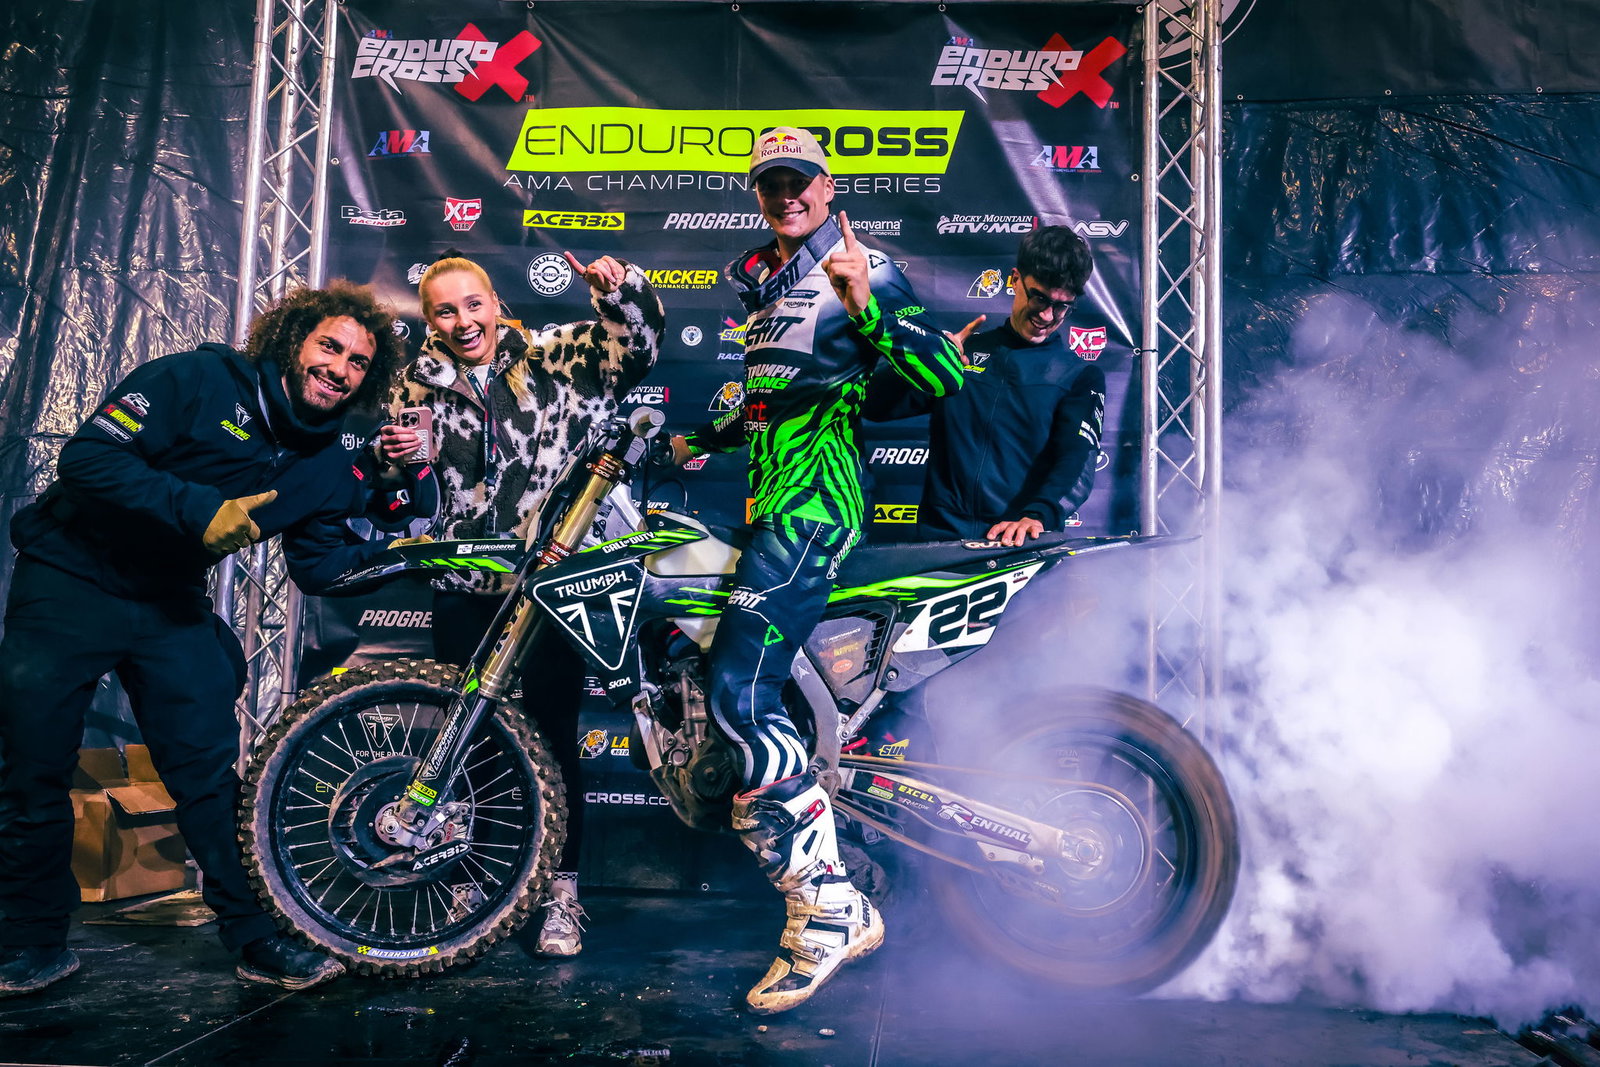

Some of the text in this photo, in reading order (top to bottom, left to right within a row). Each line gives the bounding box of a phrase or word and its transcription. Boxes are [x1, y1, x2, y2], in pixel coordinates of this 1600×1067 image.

[947, 36, 974, 46] AMA
[351, 57, 466, 95] CROSS
[931, 65, 1052, 104] CROSS
[367, 130, 431, 156] AMA
[525, 123, 948, 157] ENDUROROSS
[761, 145, 802, 157] Red Bull
[1030, 145, 1101, 169] AMA
[503, 174, 941, 193] AMA CHAMPION SERIES
[341, 205, 405, 219] Beta
[443, 201, 482, 222] XC
[662, 212, 774, 230] PROGRESSIV
[951, 214, 1033, 222] ROCKY MOUNTAIN
[848, 219, 902, 232] usqvarna
[1074, 219, 1129, 238] ASV
[532, 256, 570, 272] BULLET
[532, 278, 567, 293] PROOF
[651, 269, 719, 285] KICKER
[1069, 331, 1107, 351] XC
[1081, 352, 1096, 360] GEAR
[632, 386, 664, 394] UNTAIN
[473, 543, 517, 552] Silkolene
[602, 539, 625, 554] CALL
[629, 531, 656, 544] DUTY
[554, 570, 633, 599] TRIUMPH
[358, 609, 432, 628] PROGRE
[928, 581, 1008, 646] 22
[430, 703, 463, 767] PERFORMANCE
[433, 725, 458, 771] LUBRICANTS
[585, 792, 671, 806] CROSS.CO
[898, 784, 935, 803] EXCEL
[412, 842, 470, 872] ACERBIS
[371, 949, 420, 959] MICHELIN
